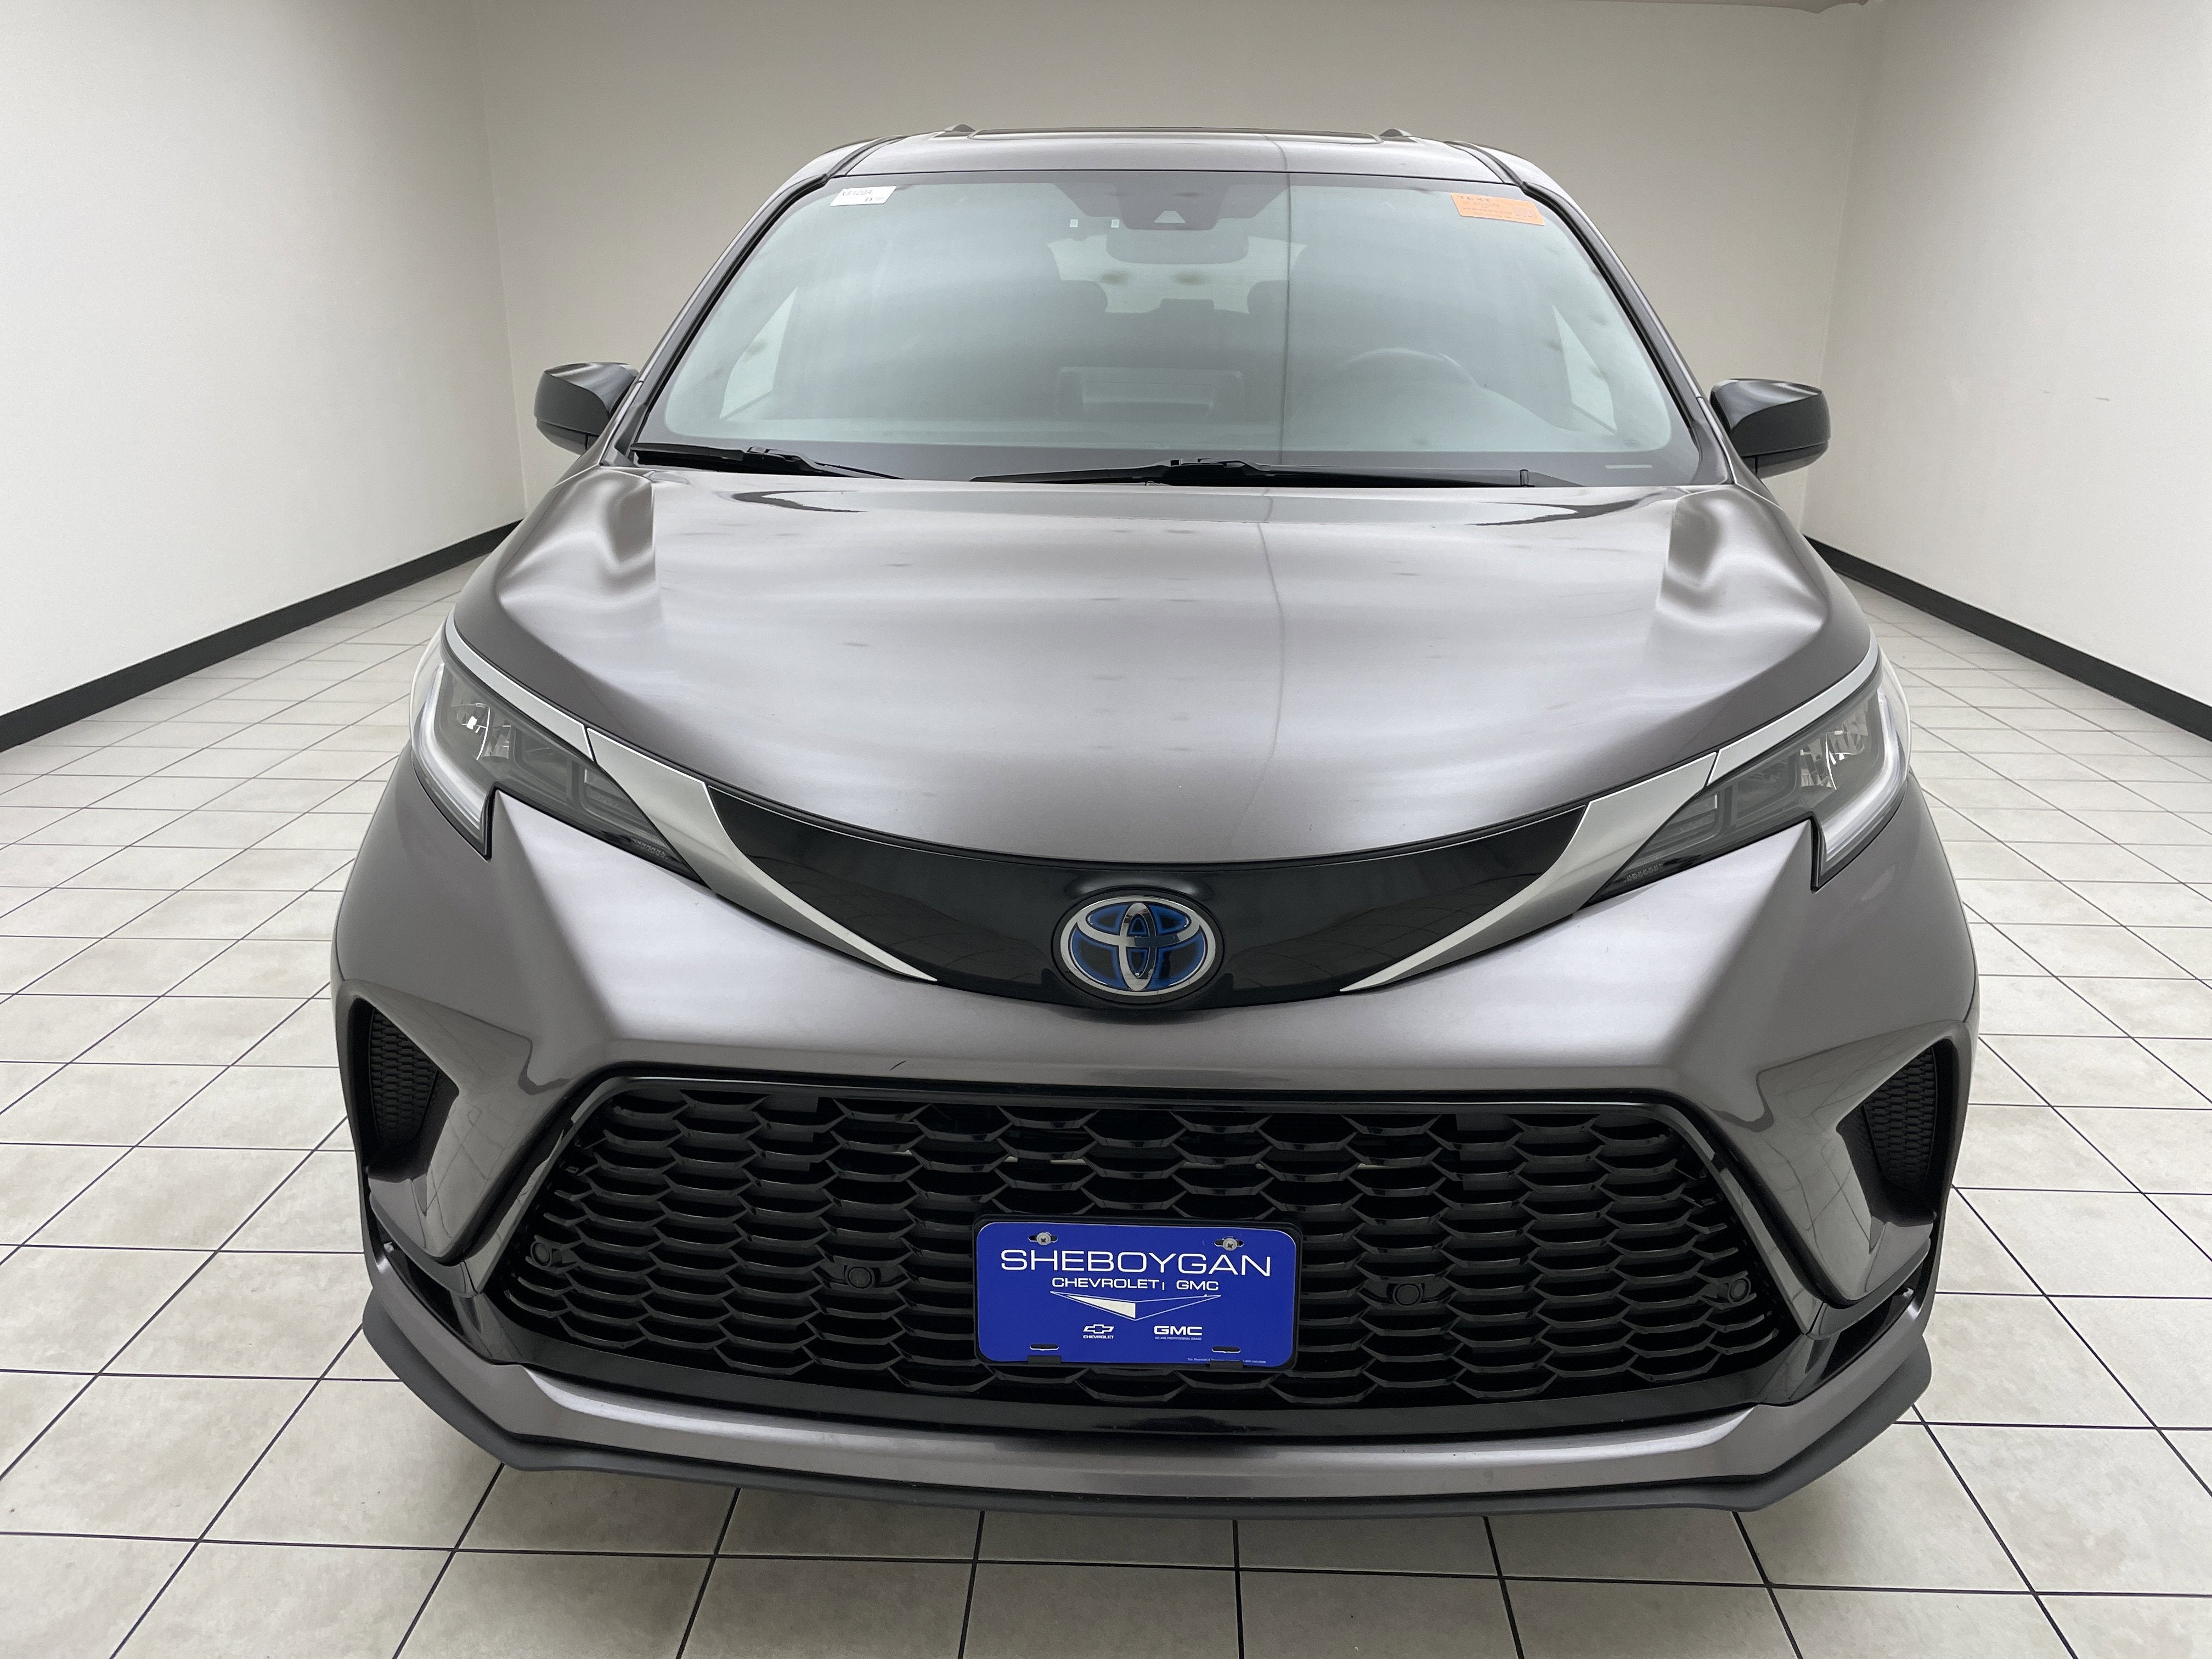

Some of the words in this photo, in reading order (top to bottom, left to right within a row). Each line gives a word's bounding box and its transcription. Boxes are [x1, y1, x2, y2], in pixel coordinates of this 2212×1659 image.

[1001, 1249, 1271, 1277] SHEBOYGAN
[1052, 1277, 1160, 1289] CHEVROLET
[1176, 1280, 1219, 1291] GMC
[1154, 1325, 1203, 1336] GMC
